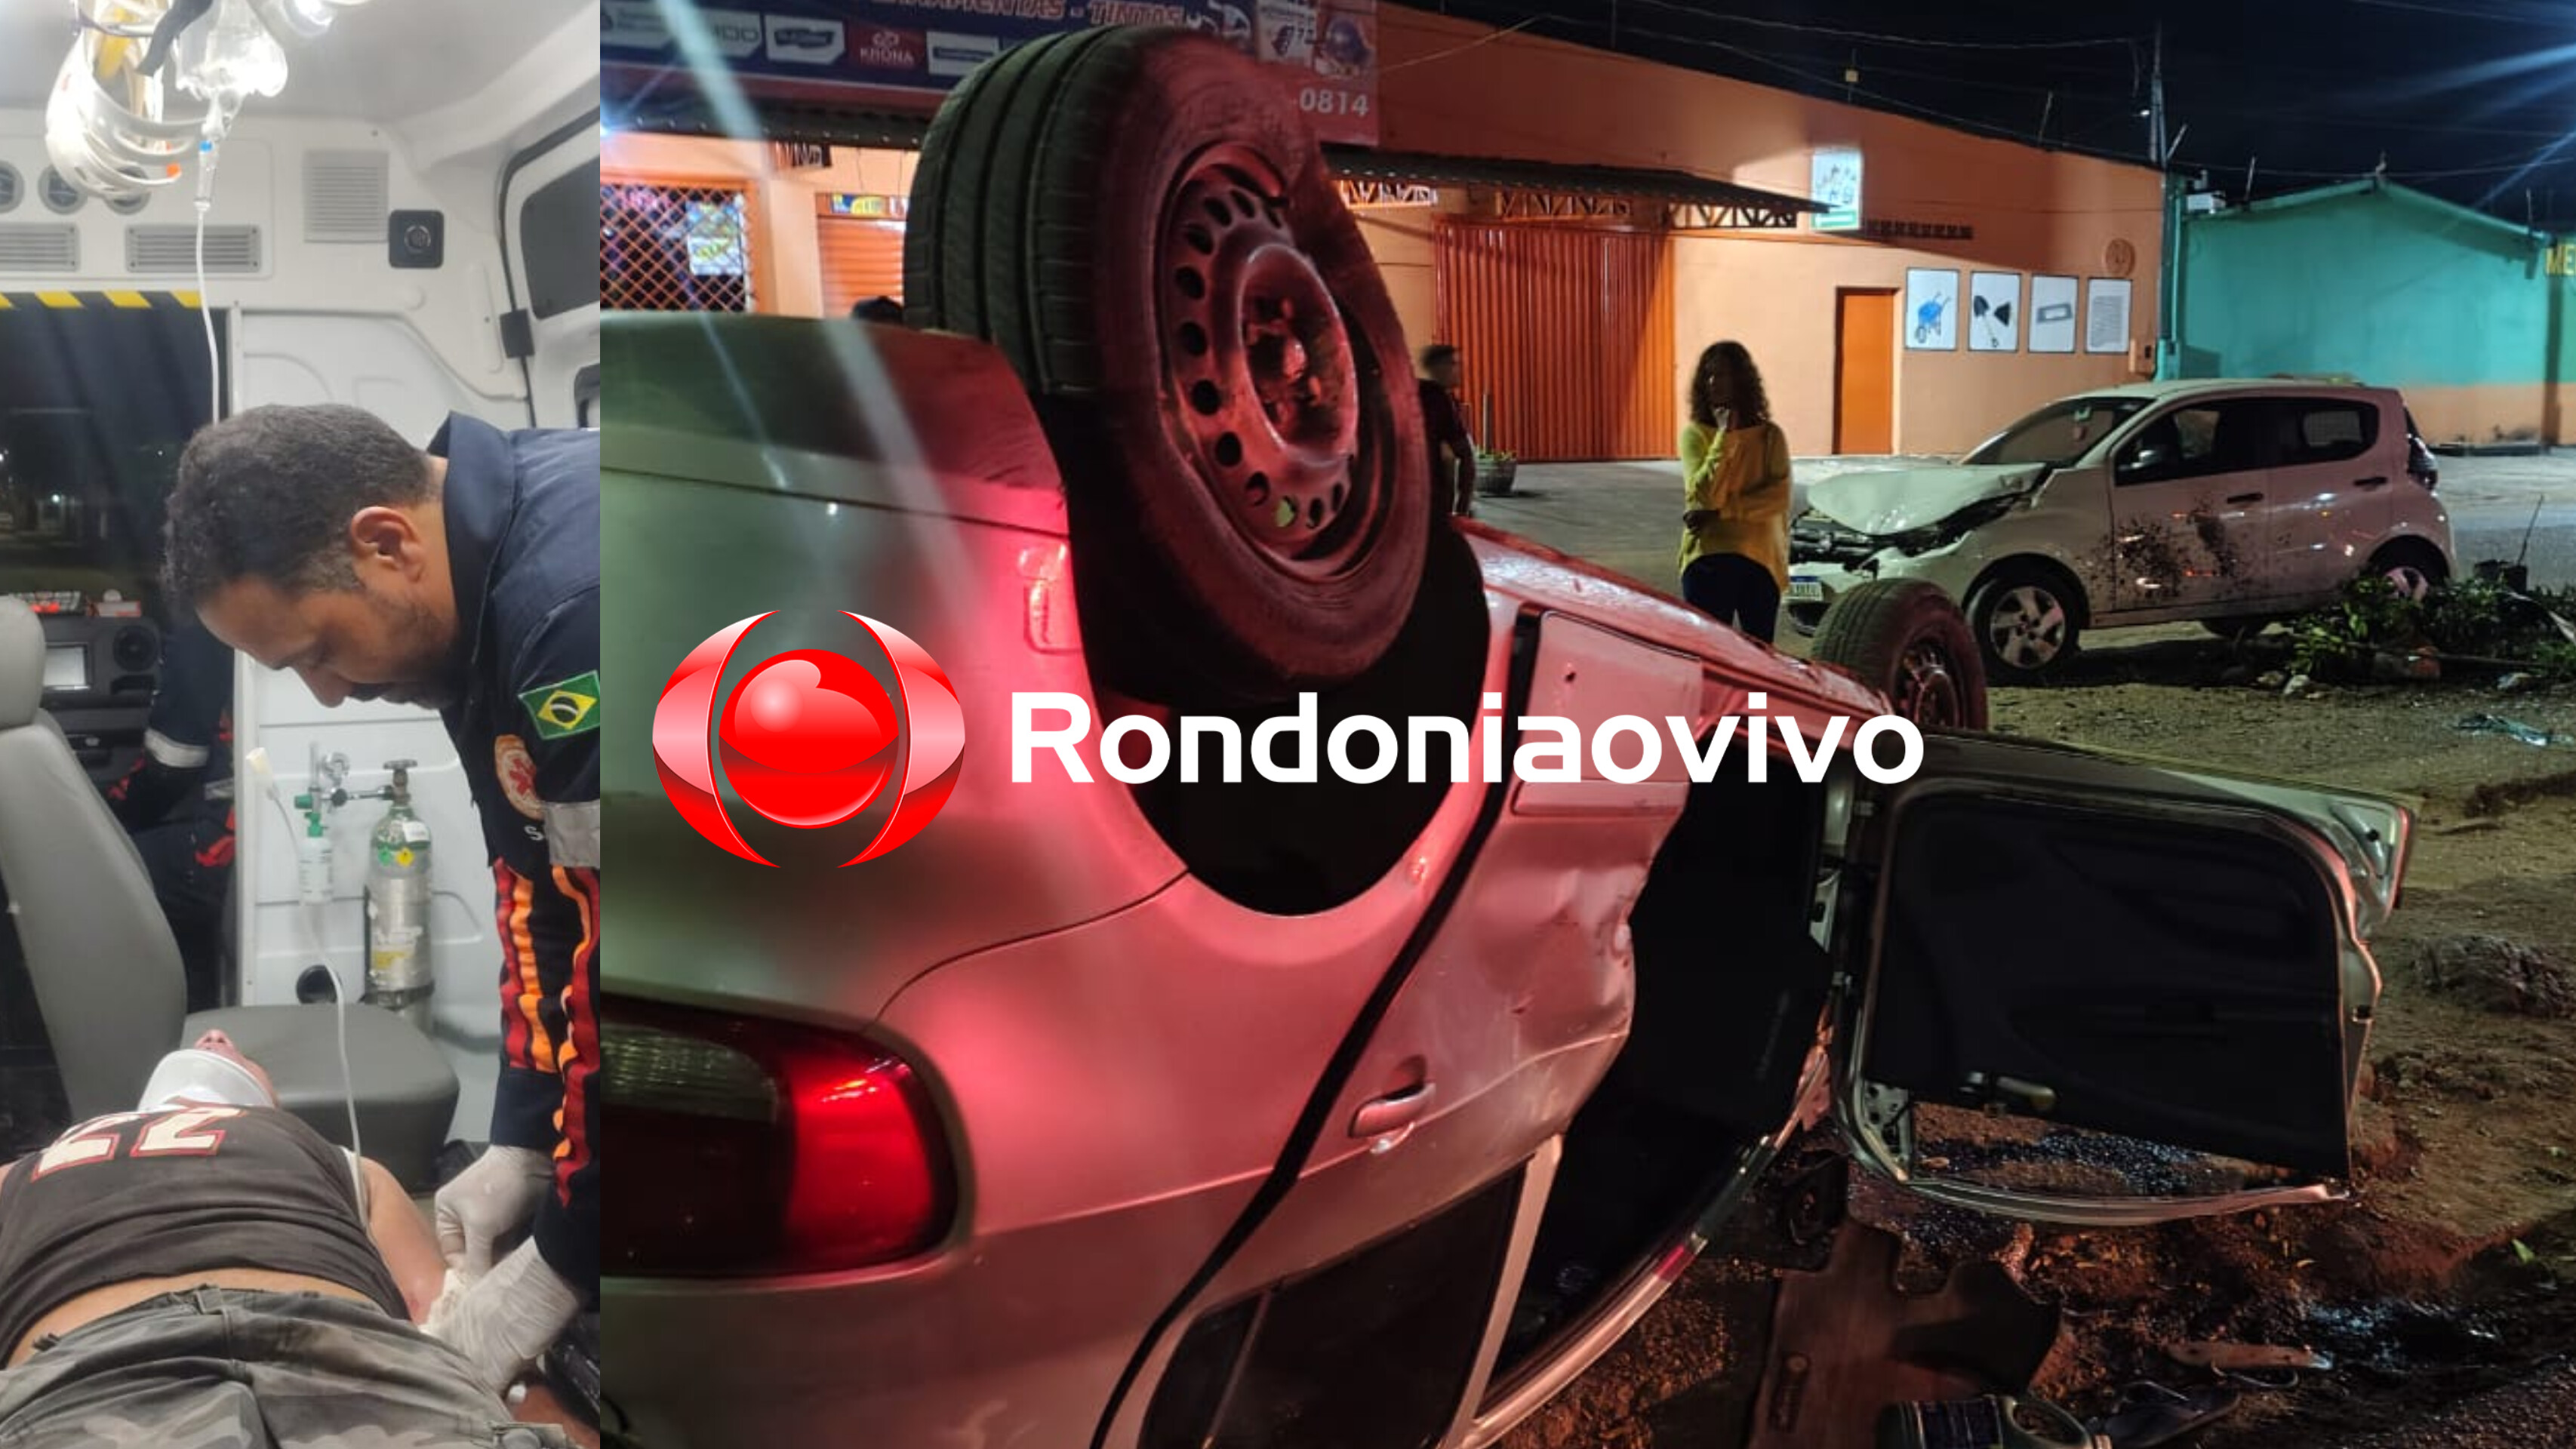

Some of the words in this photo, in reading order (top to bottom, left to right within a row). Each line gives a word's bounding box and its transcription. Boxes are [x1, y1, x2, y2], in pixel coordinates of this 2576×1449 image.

[1300, 87, 1369, 116] 0814
[2546, 244, 2576, 276] ME
[29, 1097, 248, 1184] 22
